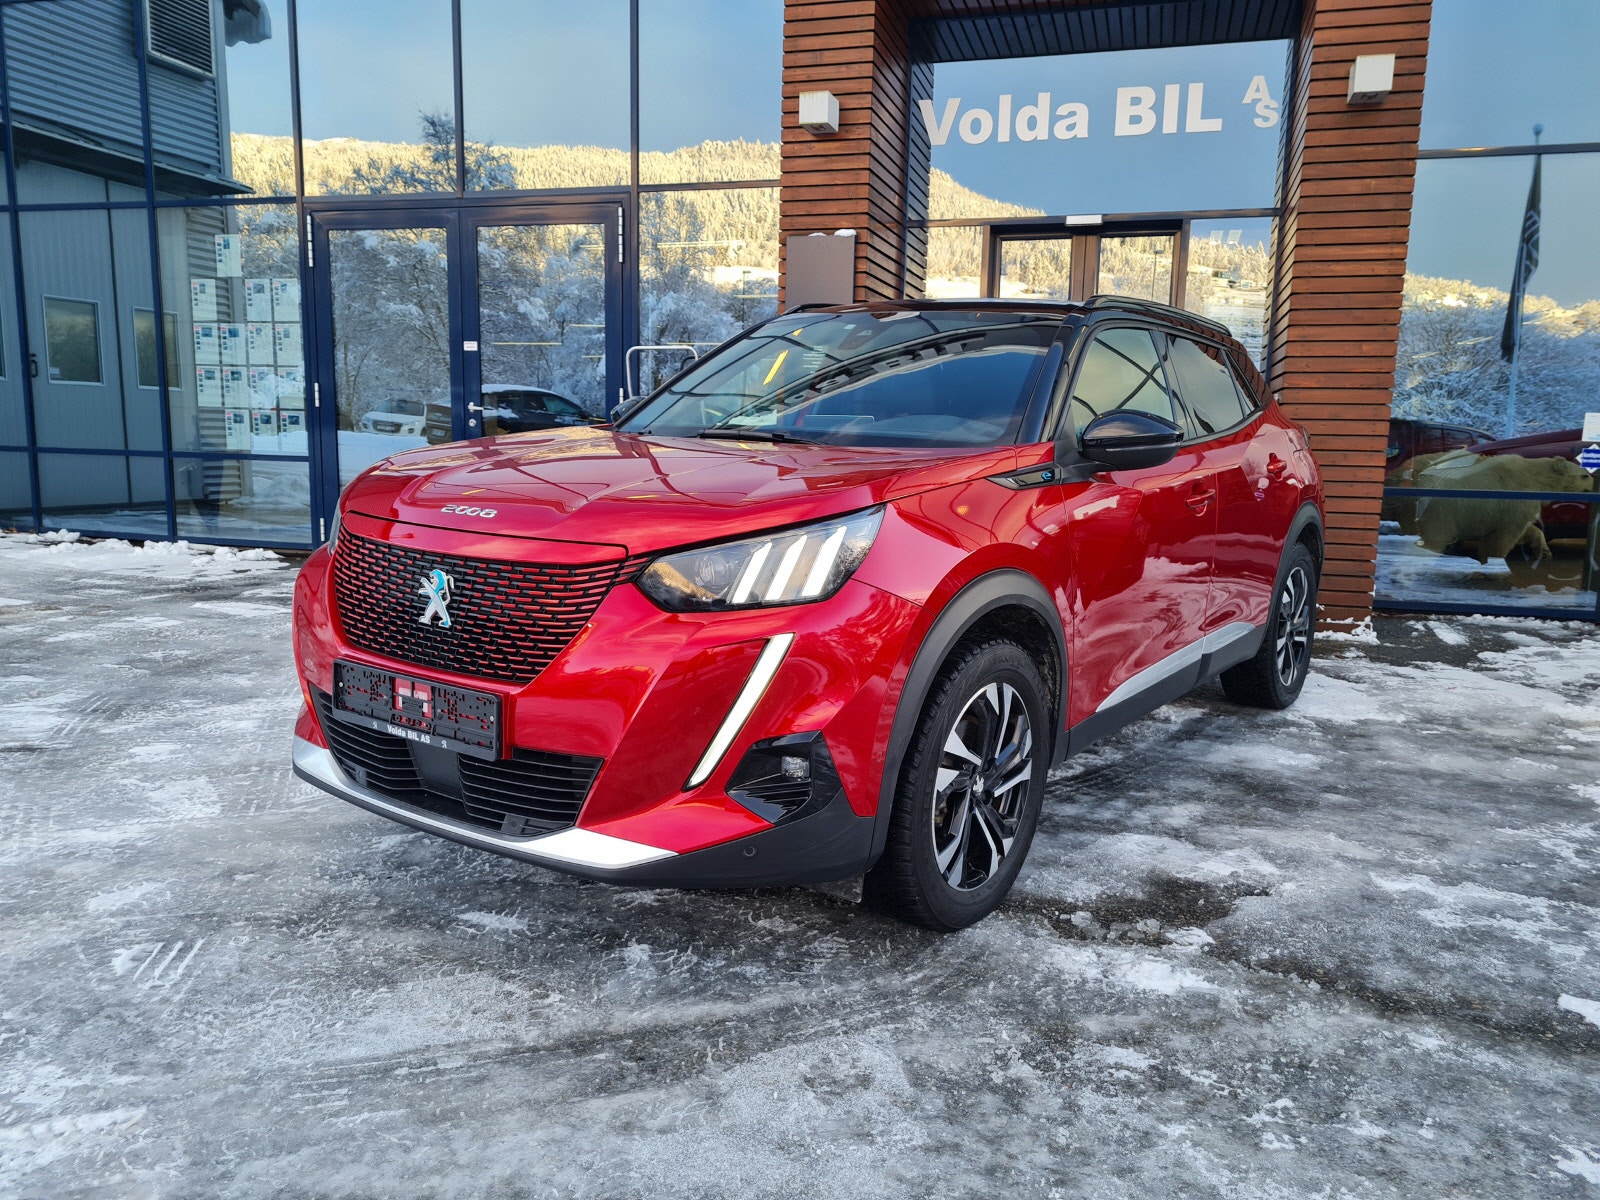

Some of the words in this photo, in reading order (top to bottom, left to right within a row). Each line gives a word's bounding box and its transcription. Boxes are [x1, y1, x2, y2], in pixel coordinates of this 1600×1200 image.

[919, 92, 1089, 146] Volda
[1114, 83, 1223, 137] BIL
[440, 504, 498, 518] 2008
[387, 724, 406, 737] Volda
[407, 730, 420, 741] BIL
[420, 734, 431, 744] AS
